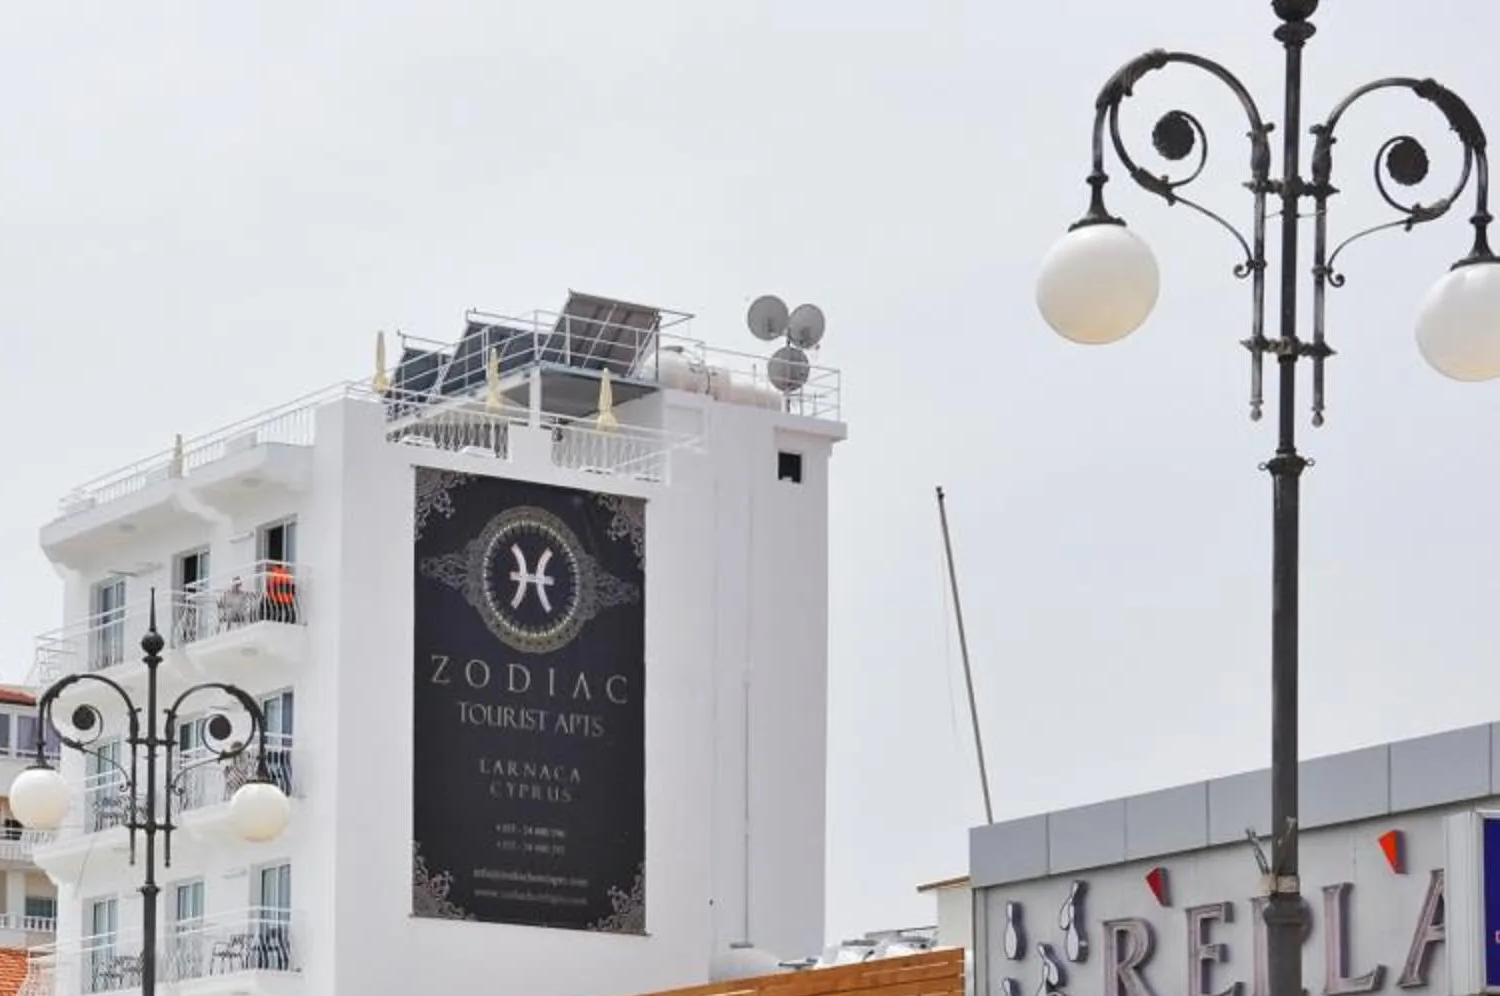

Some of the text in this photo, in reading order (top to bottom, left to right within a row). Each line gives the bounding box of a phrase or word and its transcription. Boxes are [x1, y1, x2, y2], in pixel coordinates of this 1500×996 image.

[431, 655, 628, 704] ZODIAC
[458, 701, 548, 732] TOURIST
[480, 758, 581, 783] LARNACA
[490, 781, 572, 803] CYPRUS
